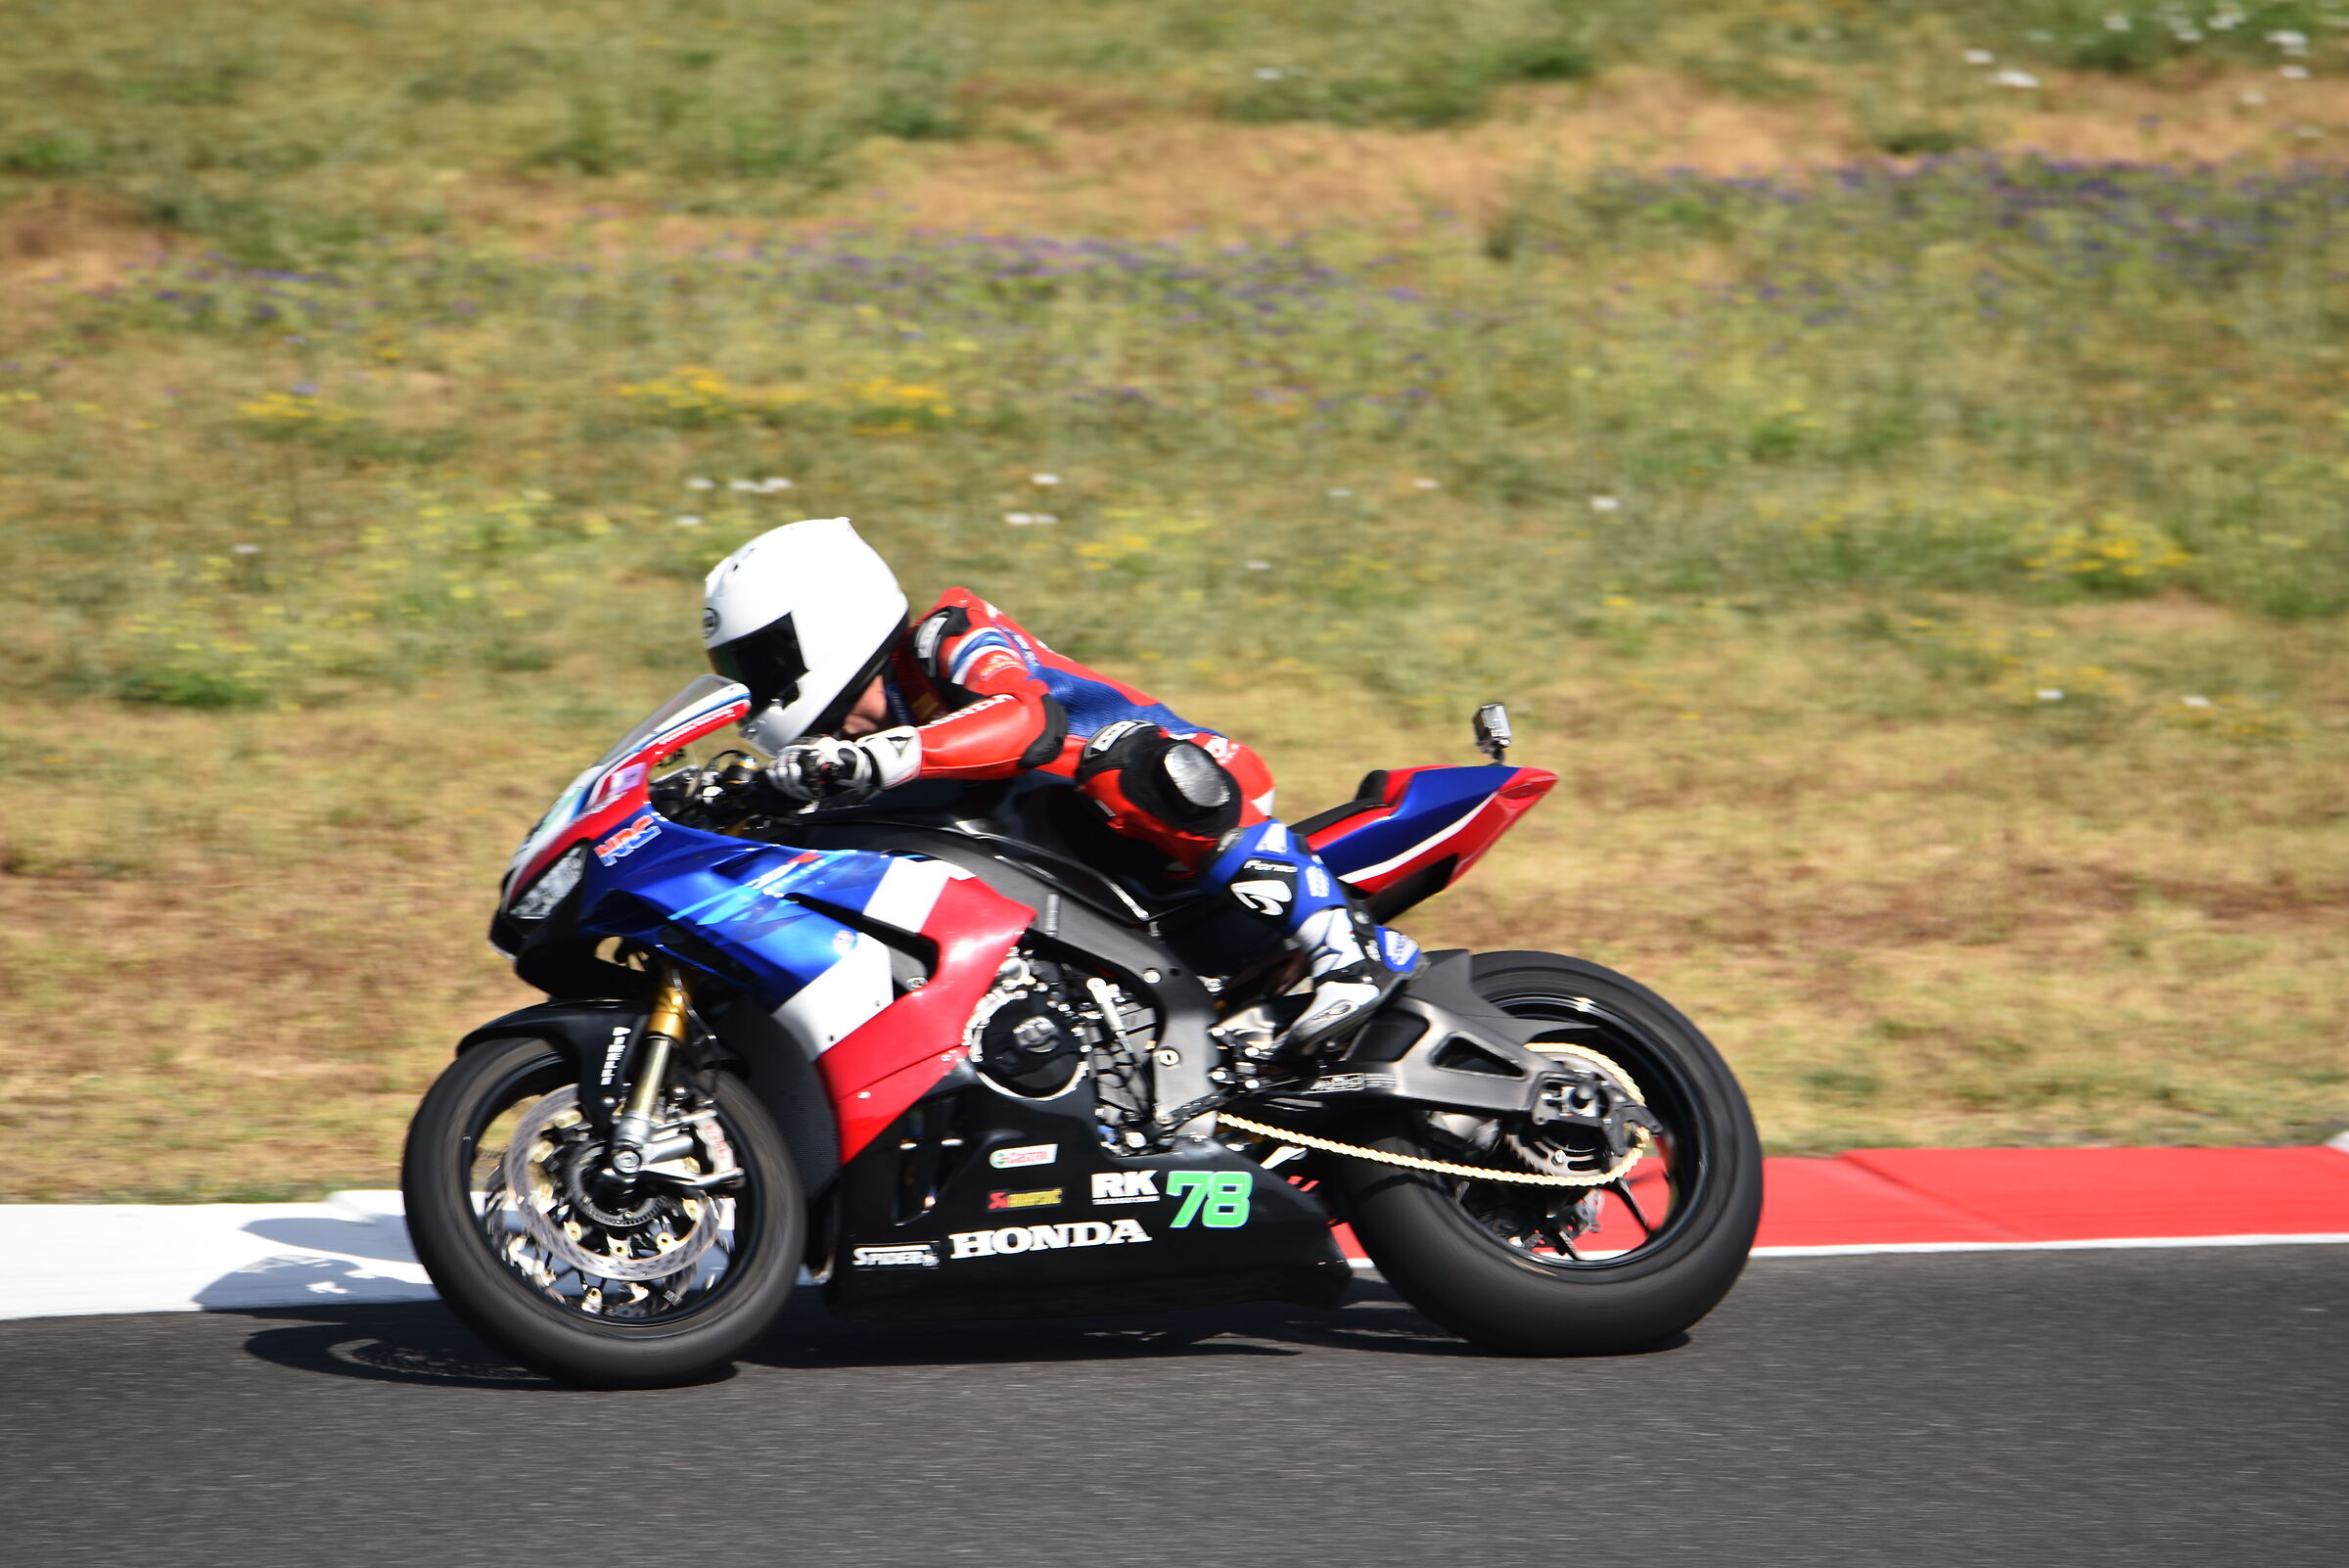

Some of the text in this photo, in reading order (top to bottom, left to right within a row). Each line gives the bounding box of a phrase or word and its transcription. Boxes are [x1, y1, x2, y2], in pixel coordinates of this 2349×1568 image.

[593, 814, 663, 867] HRC
[1090, 1170, 1160, 1199] RK
[1166, 1170, 1253, 1228] 78
[948, 1219, 1153, 1261] HONDA
